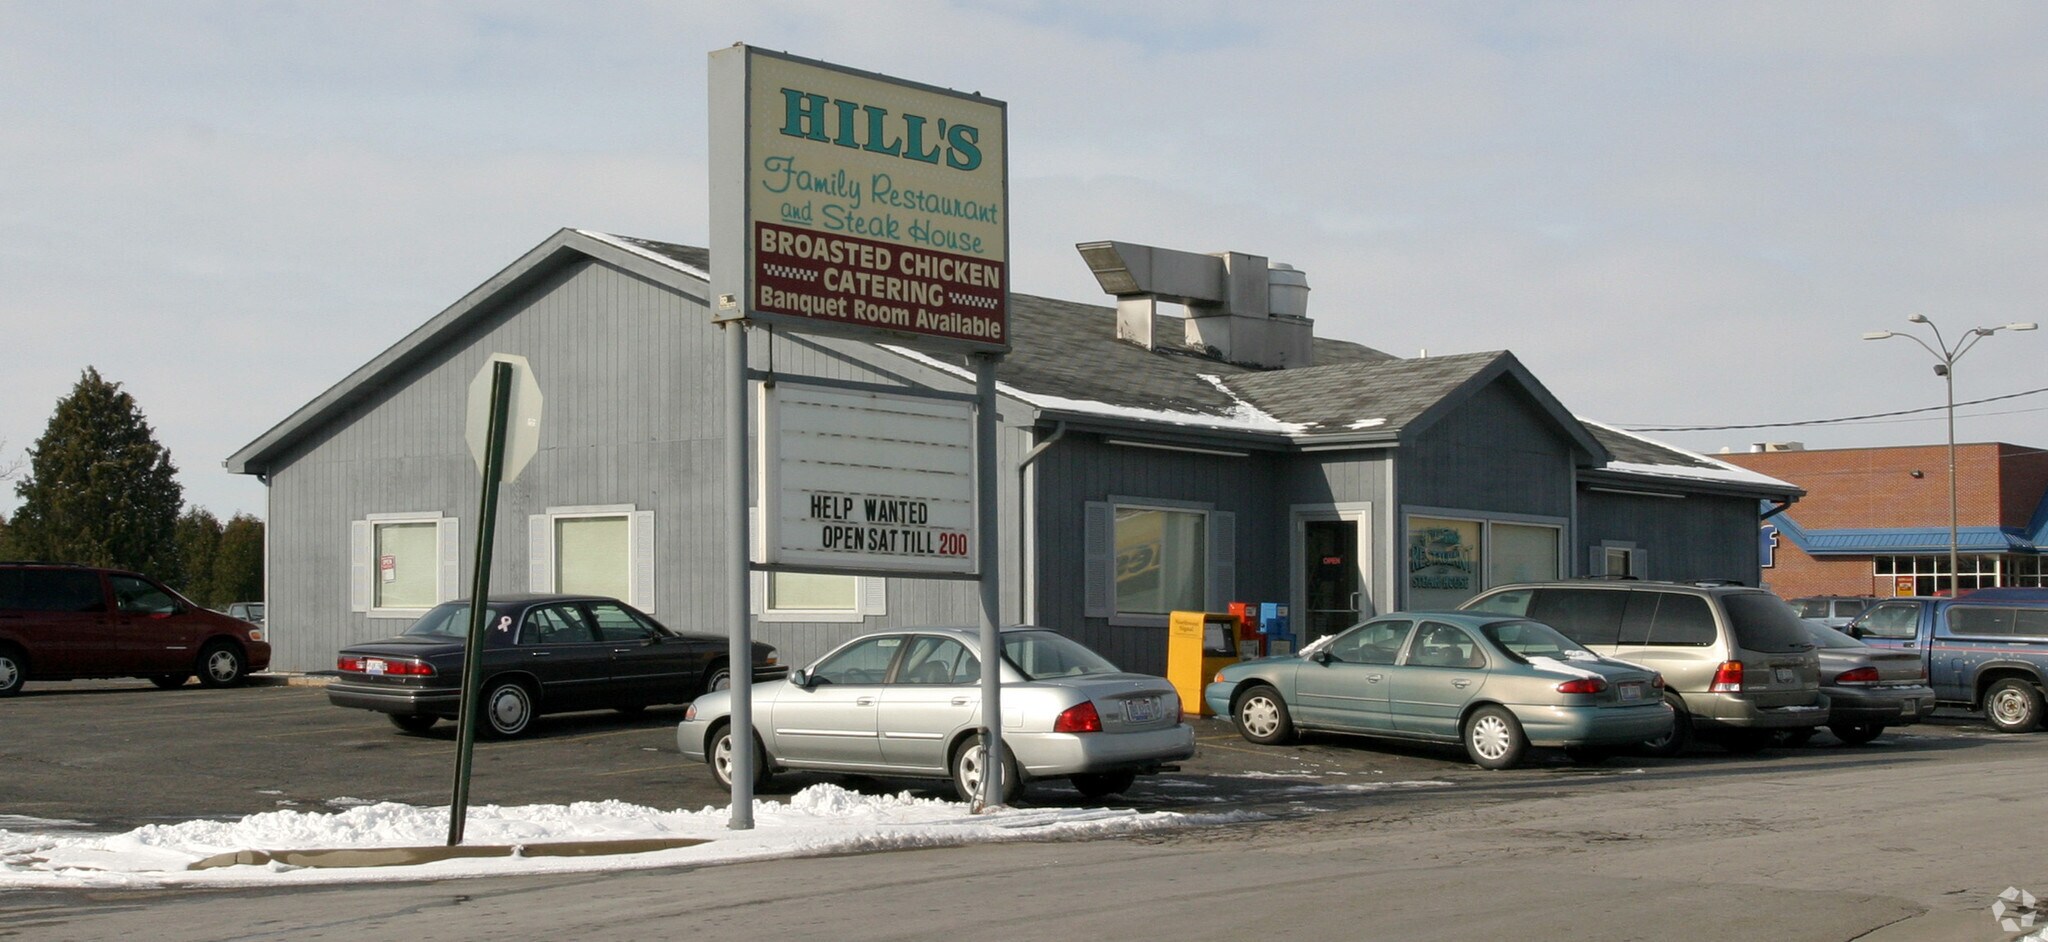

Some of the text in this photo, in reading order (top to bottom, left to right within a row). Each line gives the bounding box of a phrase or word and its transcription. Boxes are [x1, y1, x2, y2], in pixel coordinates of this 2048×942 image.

[779, 87, 983, 172] HILL'S
[762, 156, 998, 225] Family Restaurant
[781, 200, 985, 254] and Steak House
[760, 228, 1000, 289] BROASTED CHICKEN
[760, 285, 848, 318] Banquet
[854, 299, 910, 326] Room
[915, 309, 1001, 339] Available
[823, 267, 944, 307] CATERING
[810, 495, 928, 525] HELP WANTED
[822, 525, 967, 555] OPEN SAT TILL 200
[1322, 557, 1341, 565] OPEN
